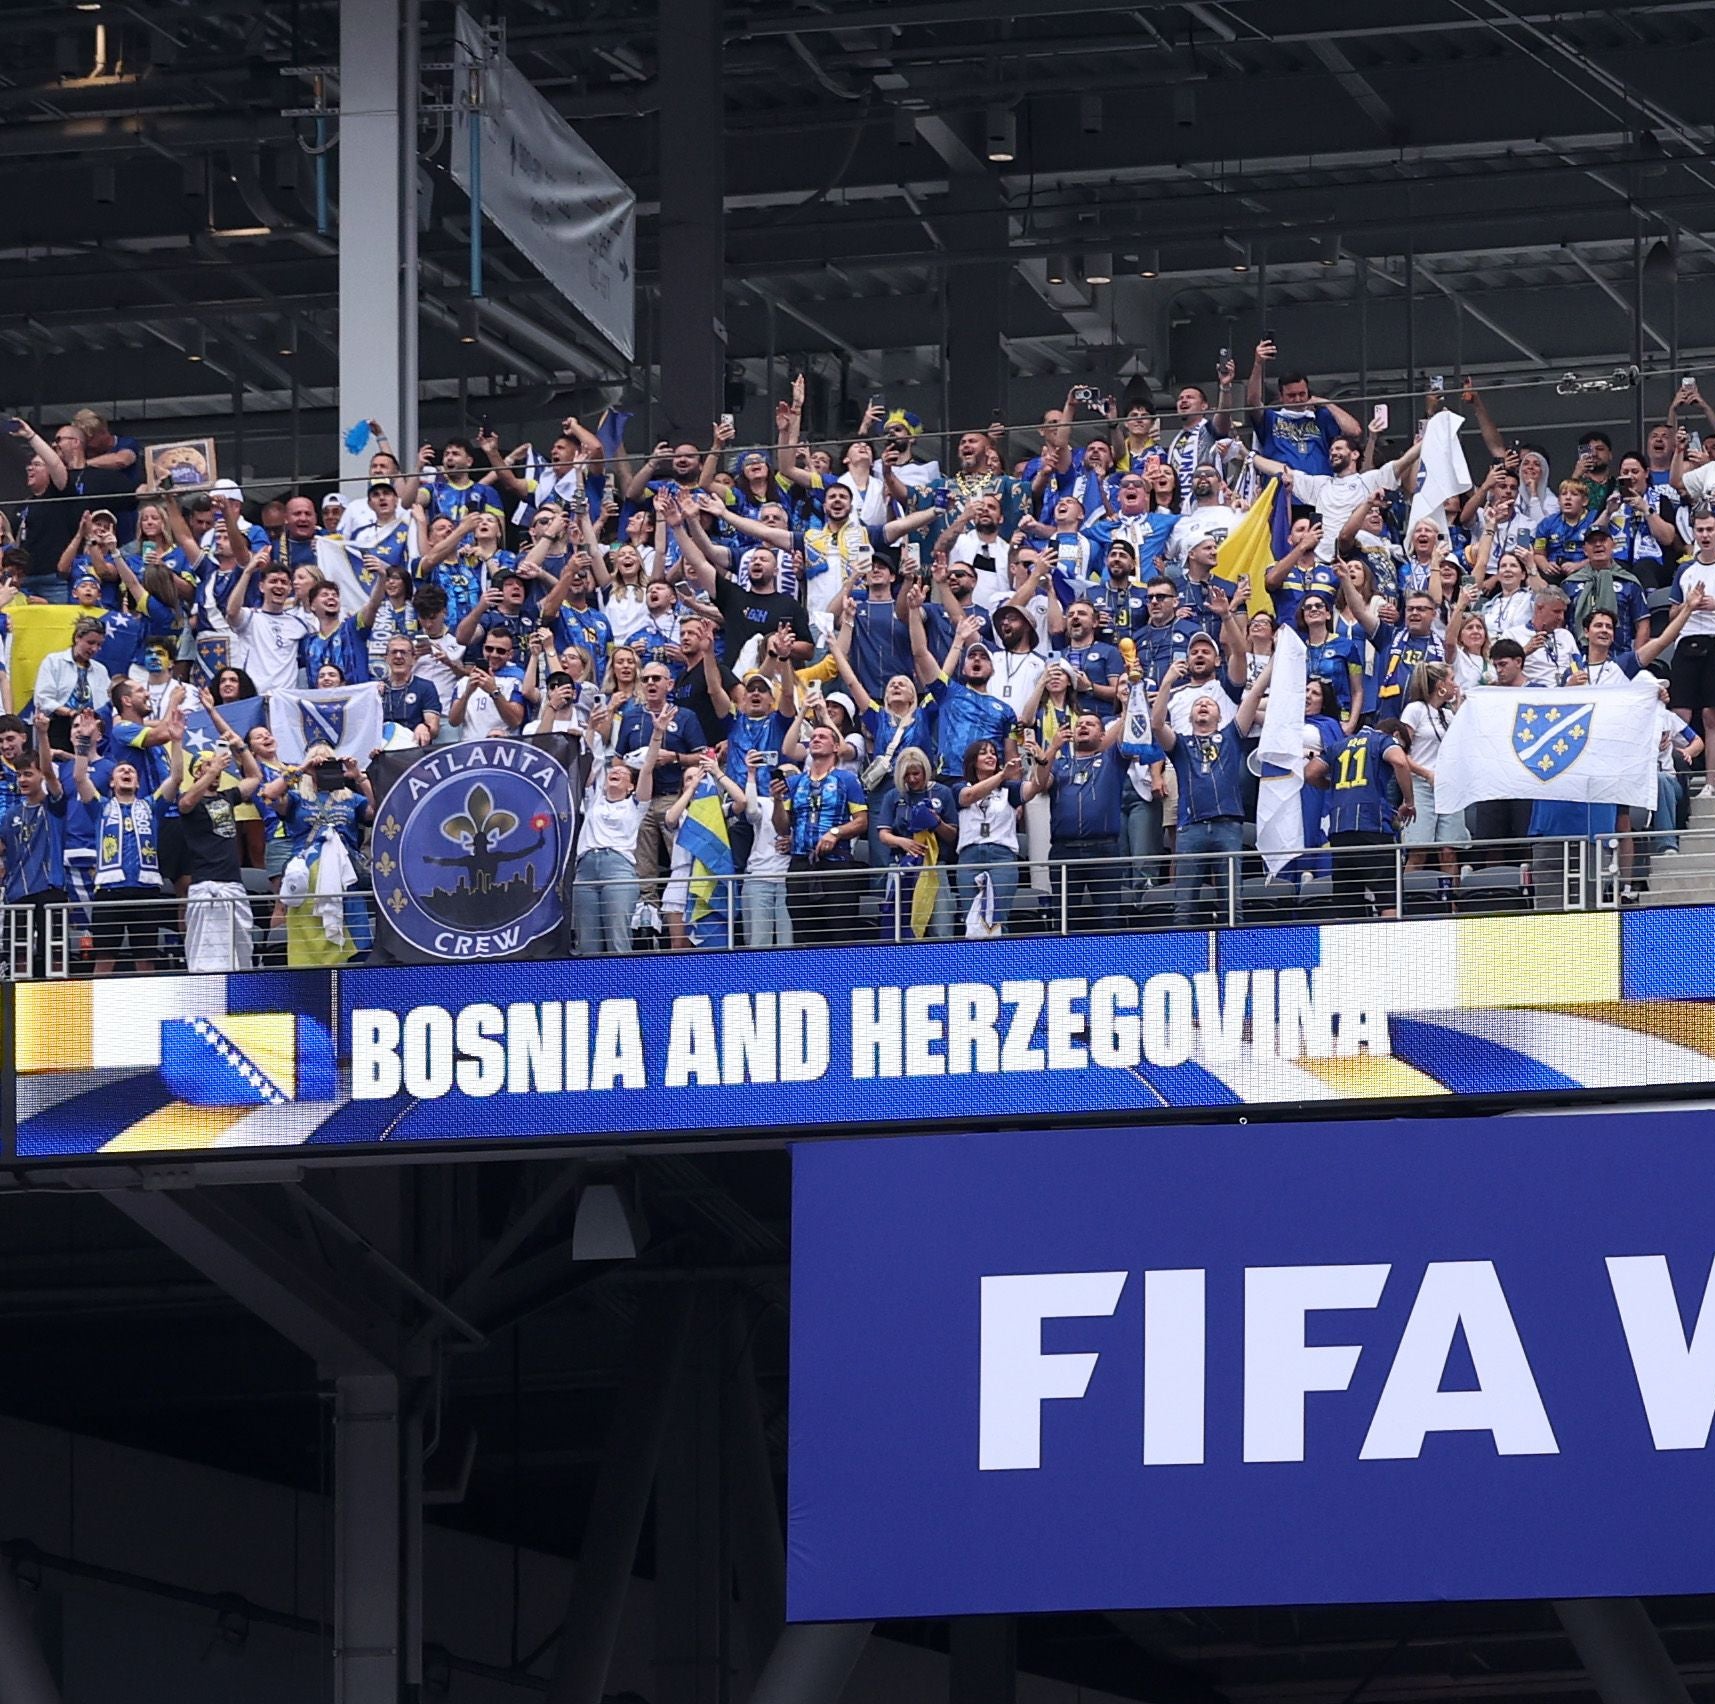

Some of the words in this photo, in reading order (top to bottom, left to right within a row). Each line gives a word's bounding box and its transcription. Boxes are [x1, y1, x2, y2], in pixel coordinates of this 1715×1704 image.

[477, 697, 487, 711] 19
[407, 745, 557, 801] ATLANTA
[1336, 747, 1367, 790] 11
[434, 926, 522, 957] CREW
[351, 999, 645, 1099] BOSNIA
[666, 984, 829, 1086] AND
[852, 966, 1394, 1078] HERZEGOVINA
[980, 1261, 1559, 1470] FIFA
